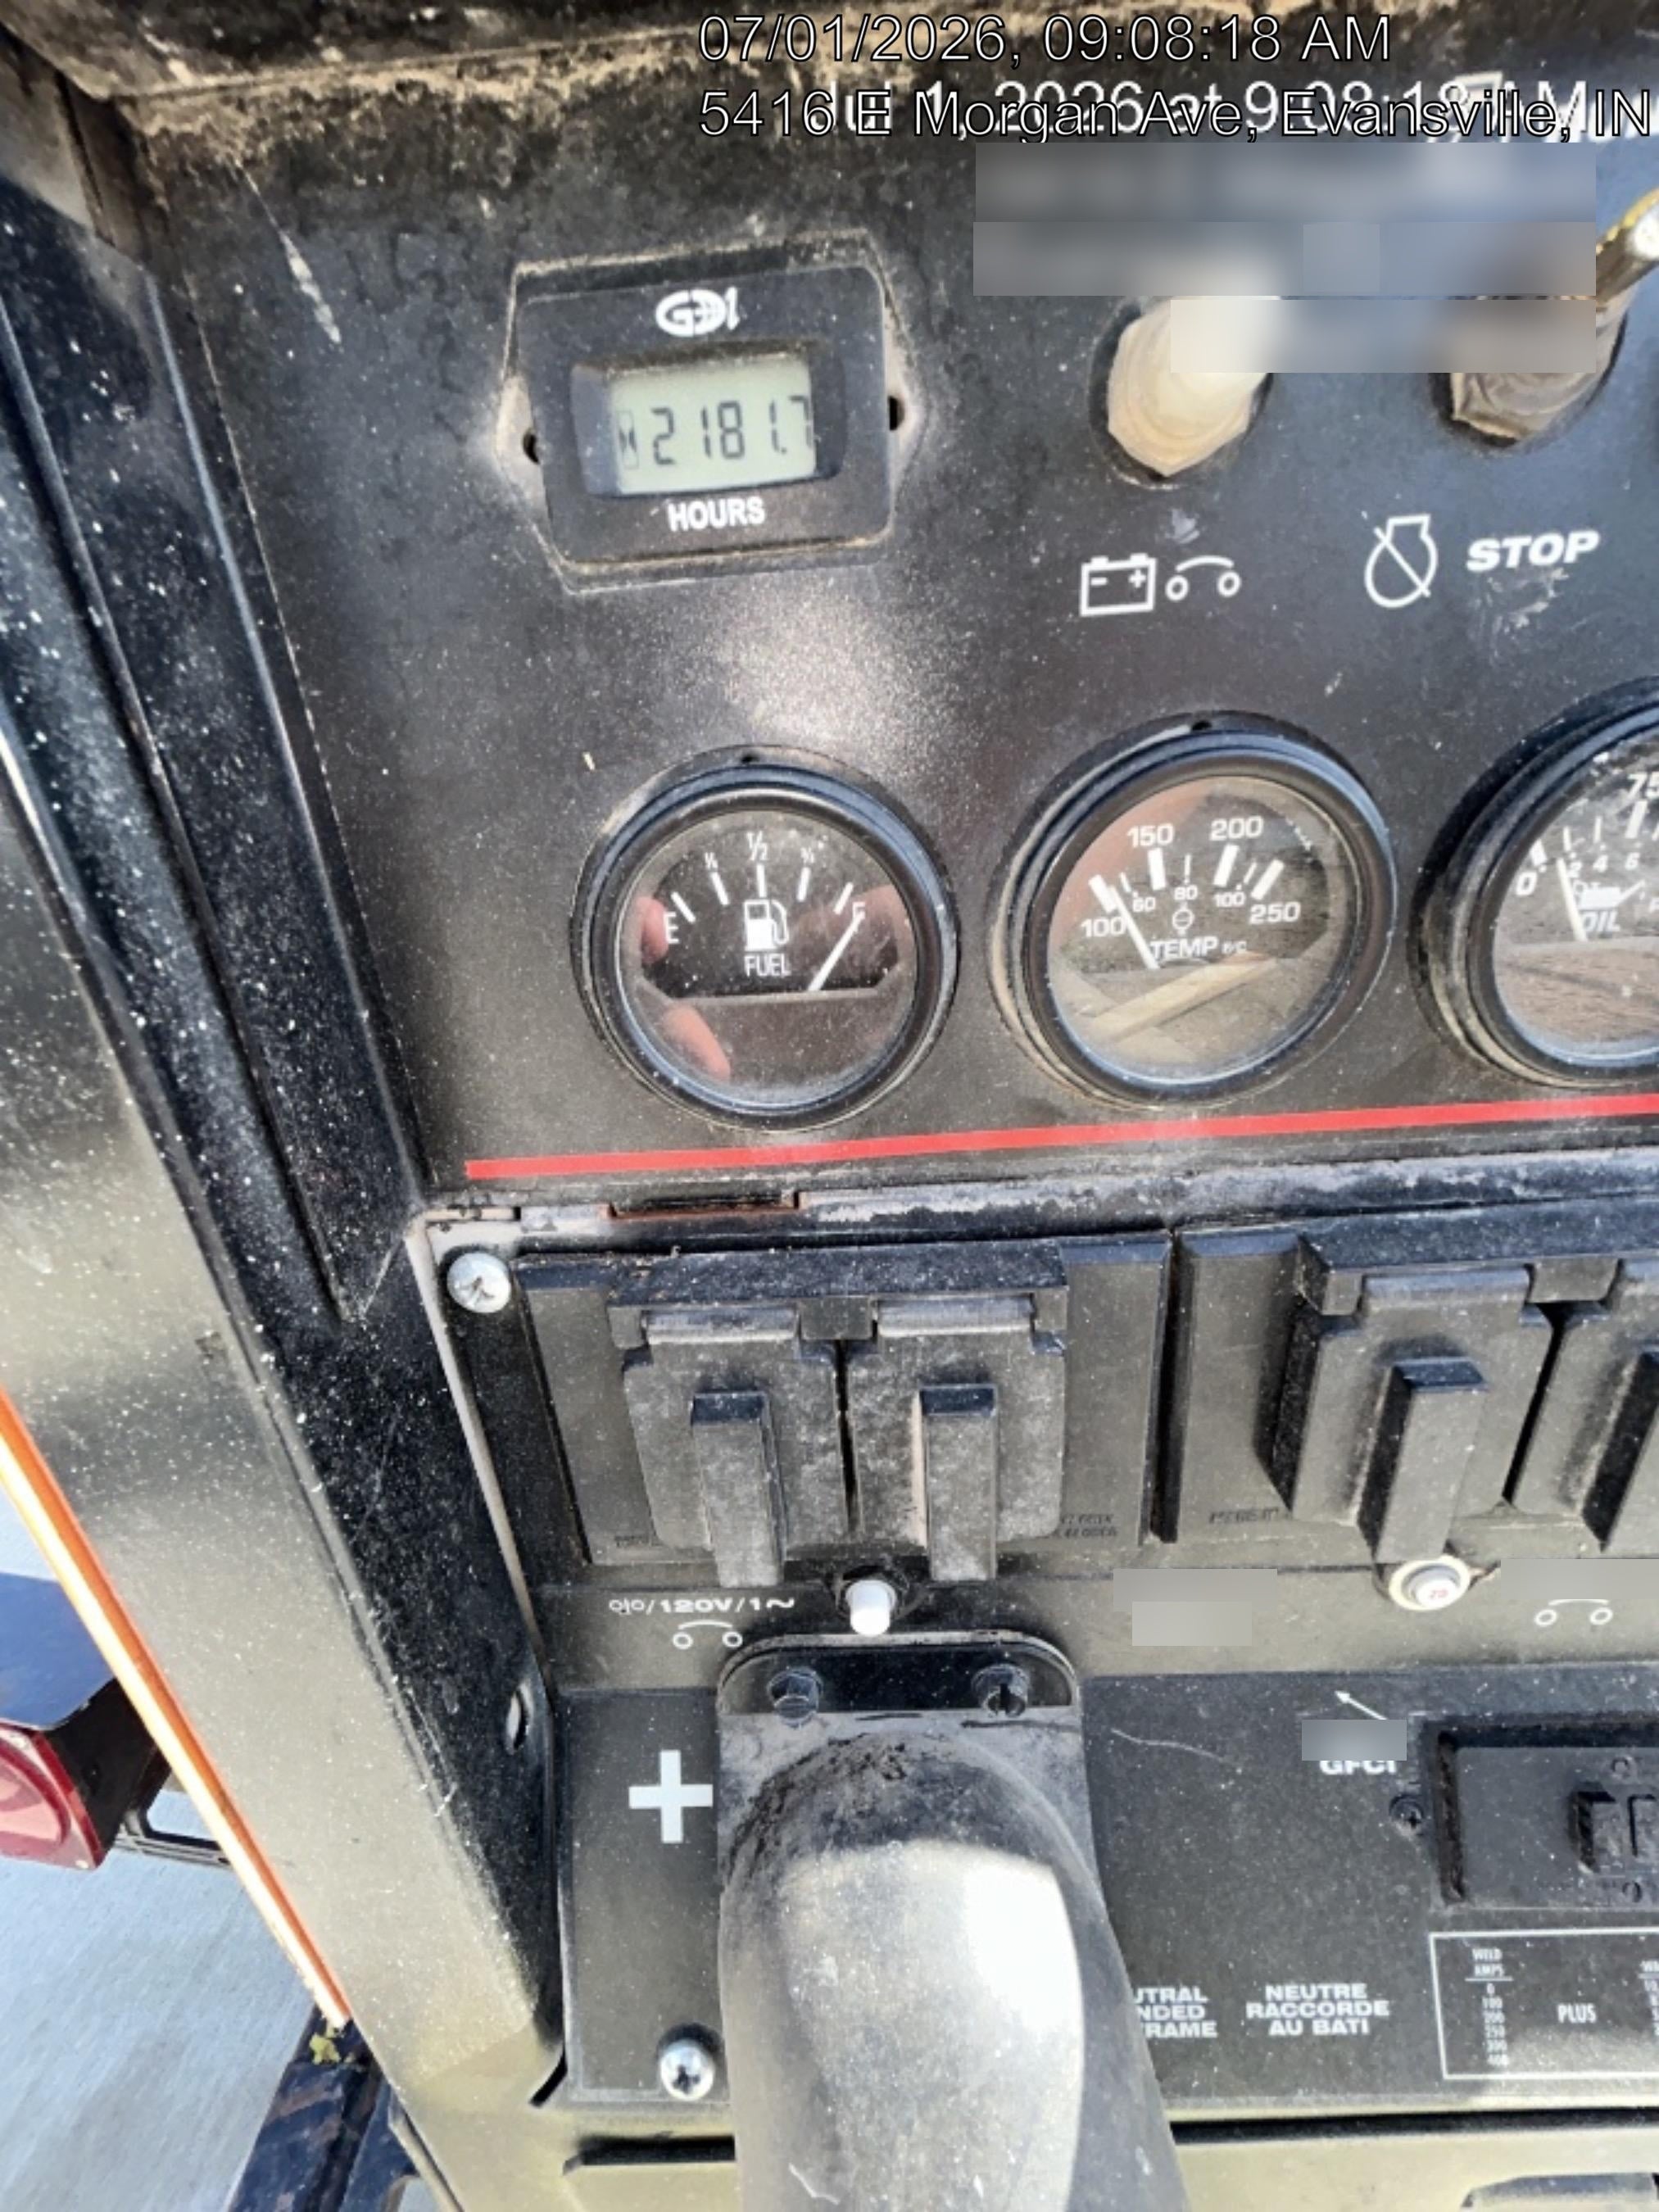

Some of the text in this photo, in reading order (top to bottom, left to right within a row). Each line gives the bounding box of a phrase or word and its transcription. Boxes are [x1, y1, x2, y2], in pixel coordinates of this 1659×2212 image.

[667, 496, 766, 533] HOURS
[1466, 529, 1601, 573] STOP
[1127, 823, 1175, 848] 150
[1209, 814, 1263, 842] 200
[1173, 884, 1199, 901] 80
[1516, 871, 1539, 897] 0
[1213, 891, 1247, 908] 100
[1249, 900, 1302, 925] 250
[1582, 909, 1622, 932] OIL
[663, 911, 680, 945] E
[1080, 915, 1128, 938] 100
[1148, 936, 1219, 959] TEMP
[744, 954, 792, 977] FUEL
[1265, 1983, 1369, 2001] NEUTRE
[1136, 2004, 1207, 2021] NDED
[1245, 2000, 1391, 2019] RACCORDE
[1557, 2002, 1598, 2024] PLUS
[1267, 2018, 1371, 2037] AU BATI
